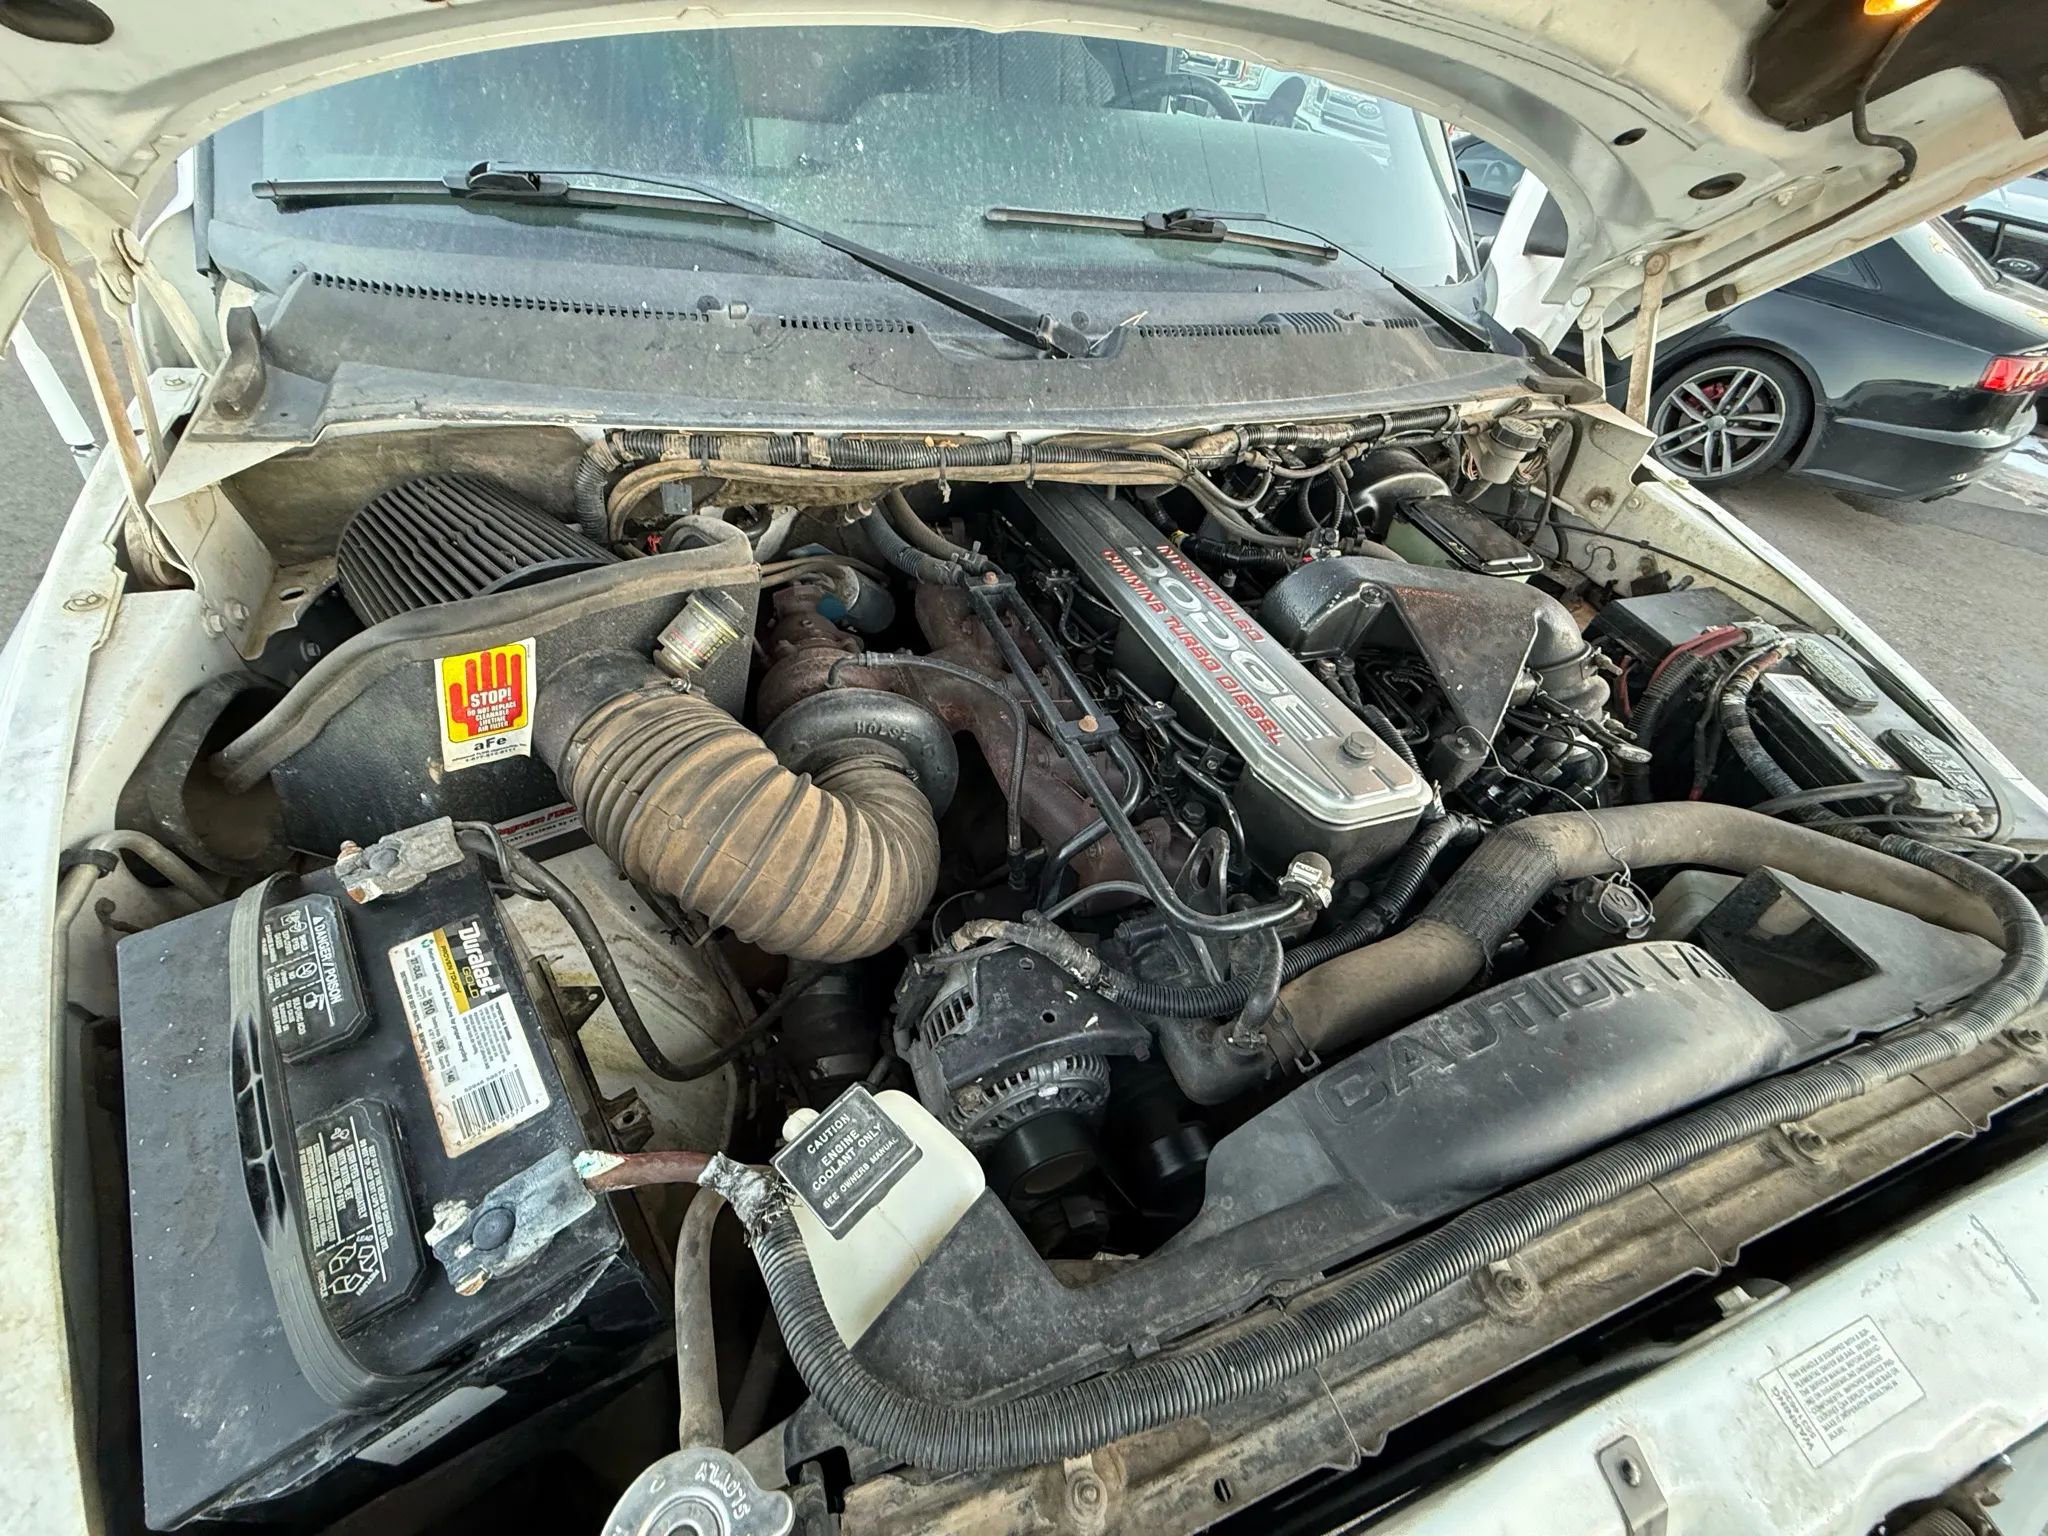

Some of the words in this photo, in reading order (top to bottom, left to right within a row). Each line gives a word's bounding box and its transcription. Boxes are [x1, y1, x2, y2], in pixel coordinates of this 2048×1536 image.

[1154, 545, 1267, 644] INTERCOOLED
[1099, 548, 1169, 616] CUMMINS
[1165, 612, 1224, 675] TURBO
[1214, 673, 1285, 748] DIESEL
[1122, 547, 1334, 743] DODGE
[469, 686, 513, 707] STOP!
[472, 734, 507, 751] aFe
[314, 923, 331, 962] DANGER
[323, 967, 342, 1004] POISON
[439, 944, 453, 971] PROVEN
[449, 970, 461, 994] TOUGH
[456, 920, 501, 998] Duralast
[461, 965, 480, 1000] GOLD
[421, 998, 435, 1016] 810
[435, 1038, 446, 1053] 930
[1312, 954, 1656, 1126] CAUTION
[445, 1069, 455, 1083] 140
[805, 1112, 850, 1154] CAUTION
[810, 1146, 858, 1191] COOLANT
[856, 1121, 884, 1148] ONLY
[820, 1128, 860, 1166] ENGINE
[822, 1191, 840, 1209] SEE
[869, 1135, 899, 1164] MANUAL
[1769, 1385, 1815, 1451] WARNING
